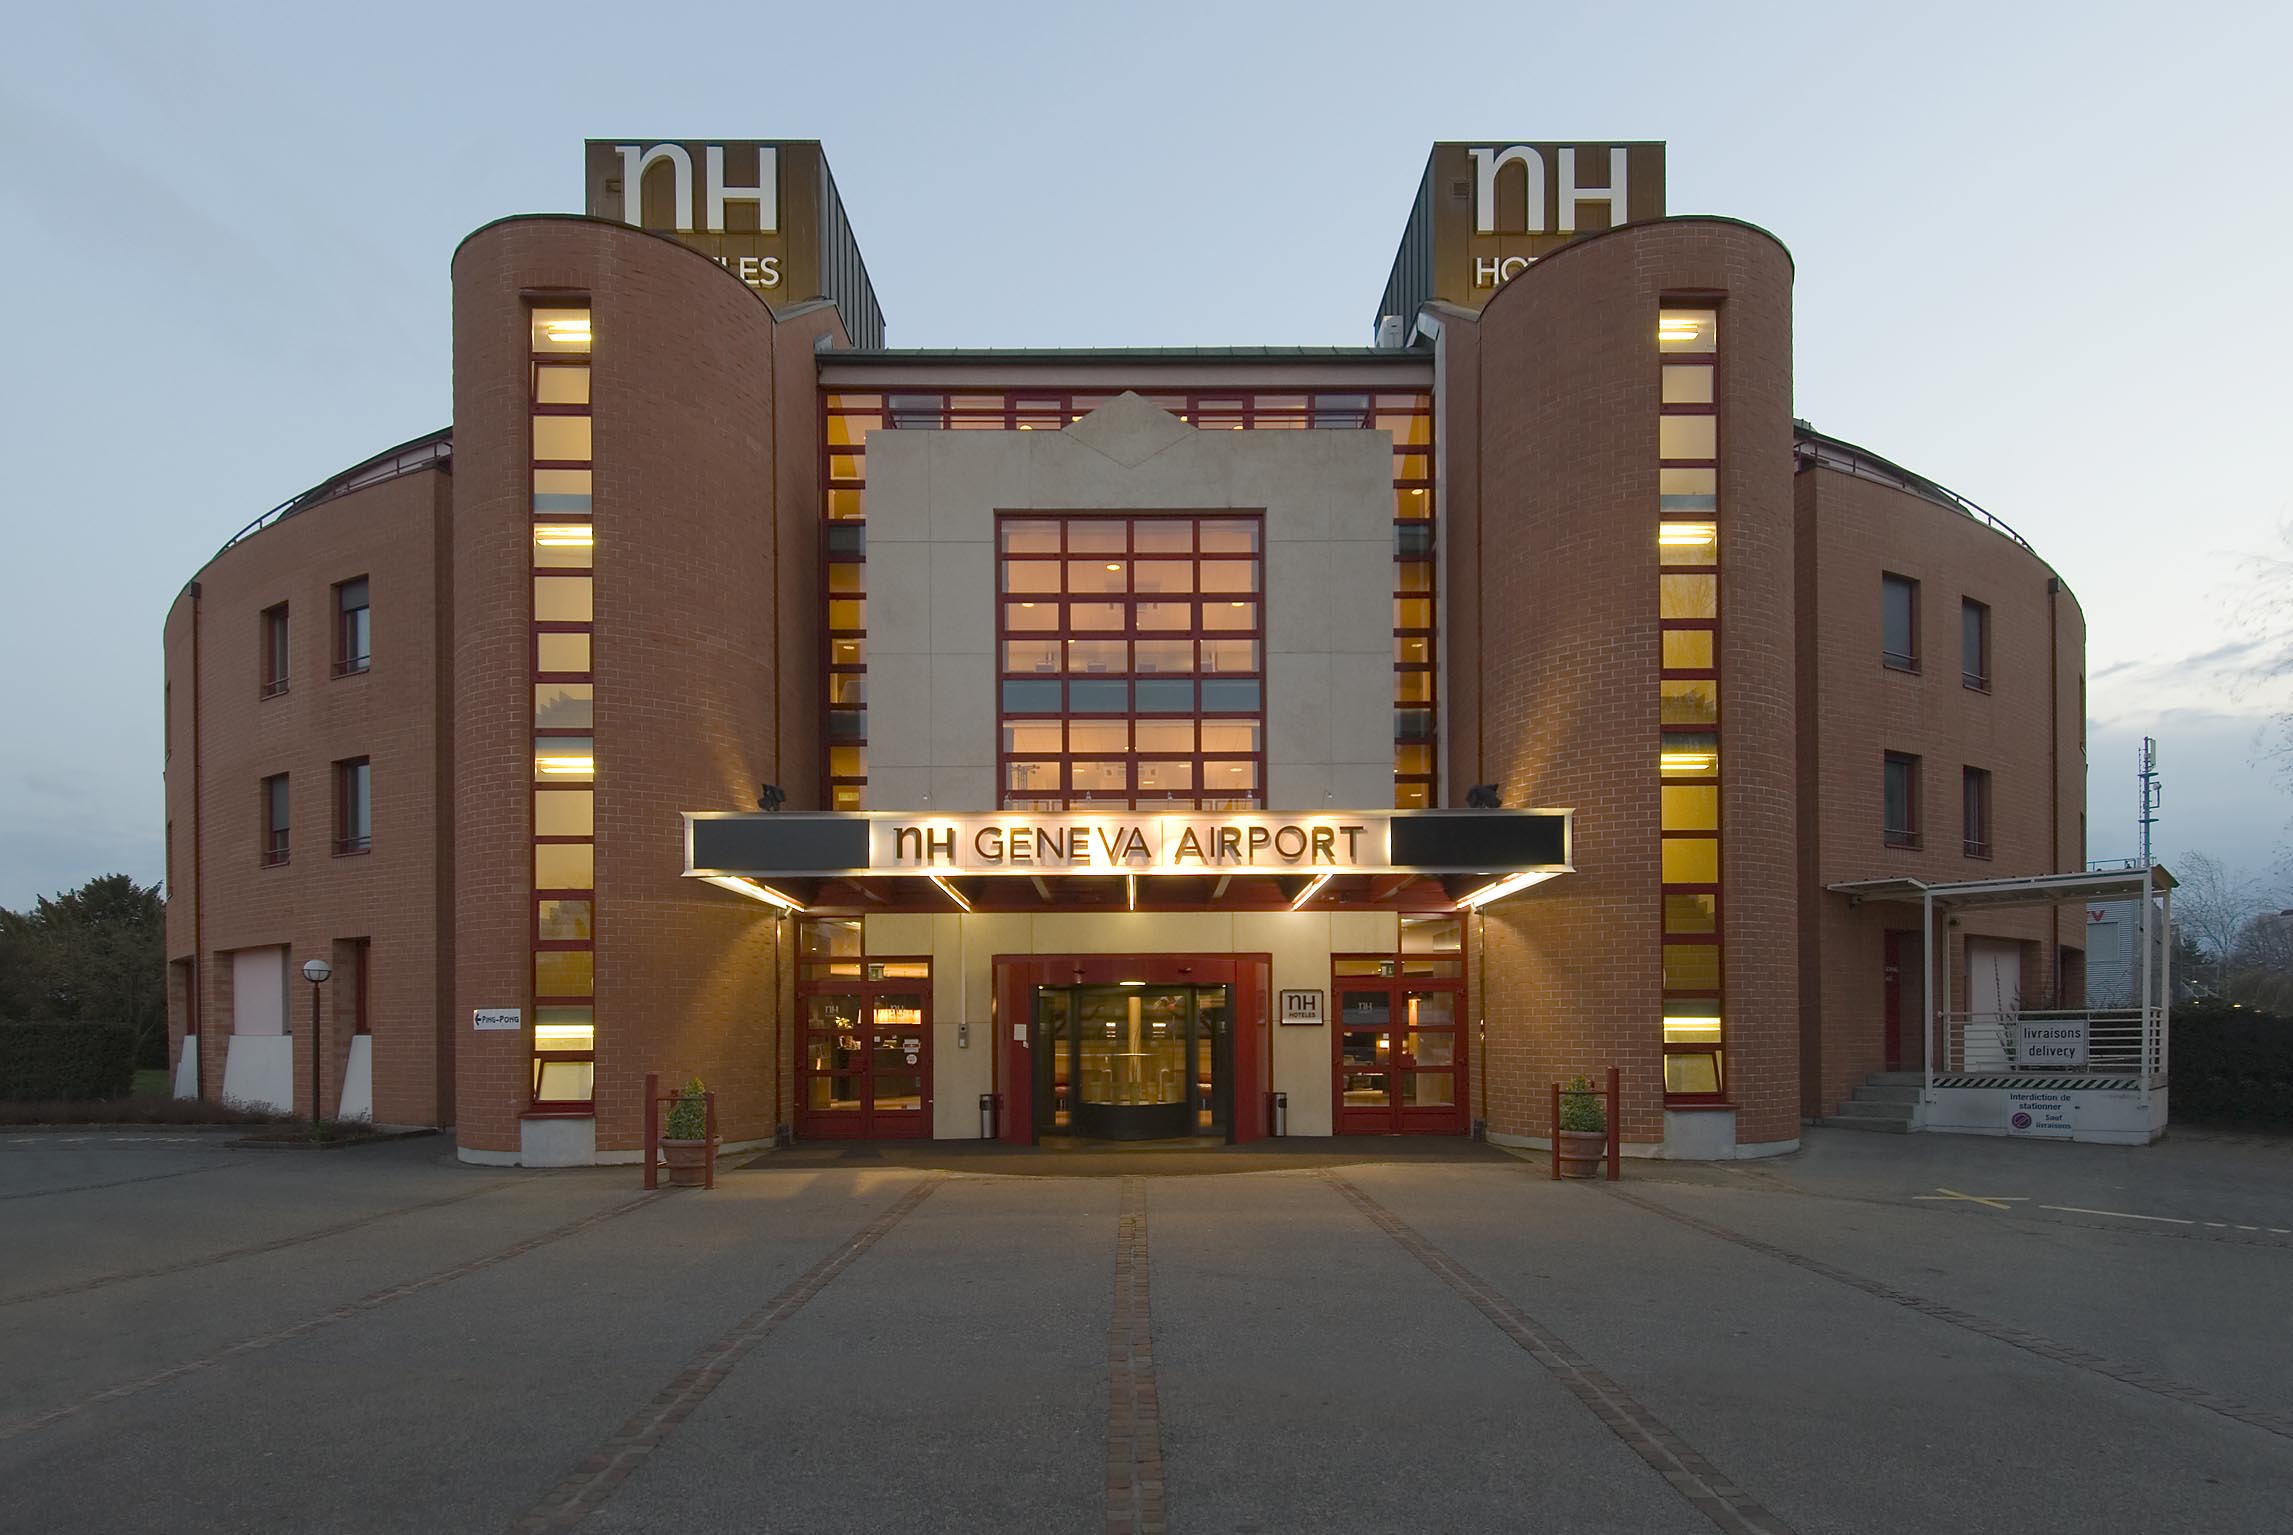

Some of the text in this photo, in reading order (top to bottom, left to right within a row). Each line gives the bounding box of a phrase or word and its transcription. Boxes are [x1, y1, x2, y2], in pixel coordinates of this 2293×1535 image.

[974, 826, 1152, 861] GENEVA
[1175, 825, 1364, 859] AIRPORT
[2024, 1027, 2081, 1039] livraisons
[2029, 1045, 2076, 1059] delivery
[2010, 1094, 2072, 1102] Interdiction de
